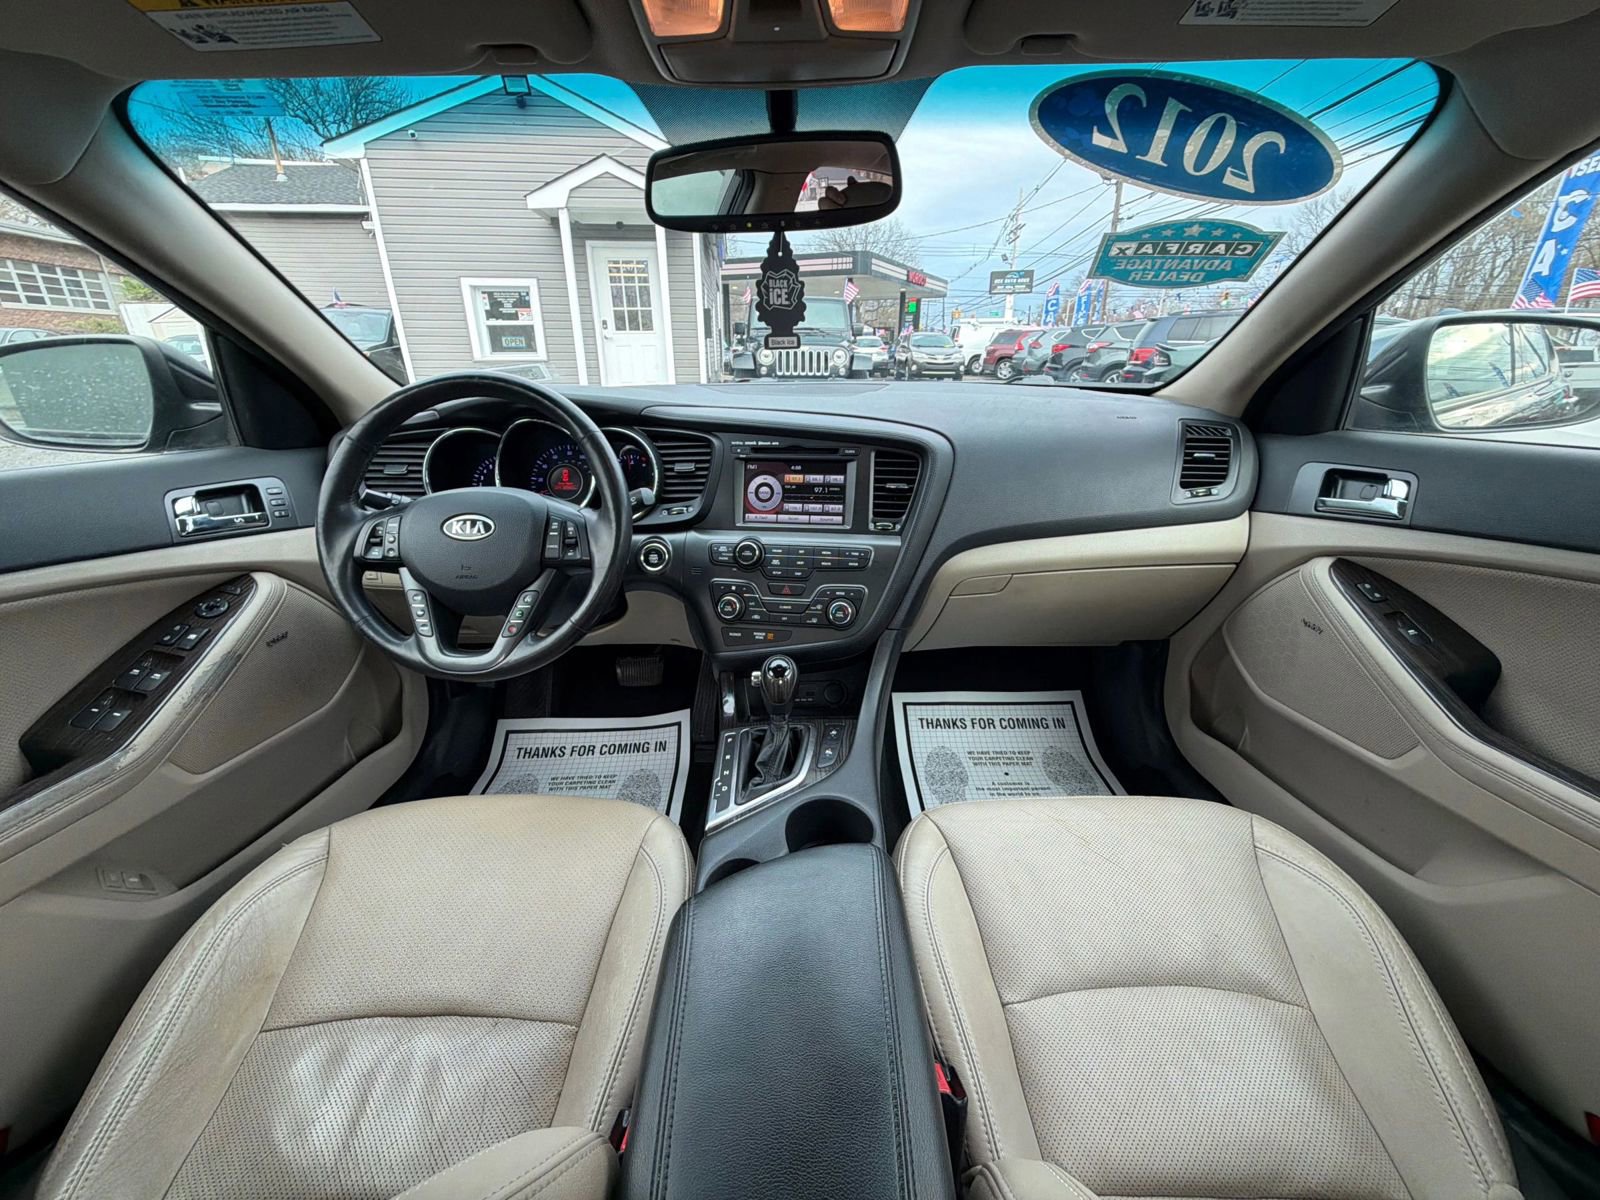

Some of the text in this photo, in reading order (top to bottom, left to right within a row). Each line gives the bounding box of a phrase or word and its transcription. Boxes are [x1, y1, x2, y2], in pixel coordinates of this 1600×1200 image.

[768, 279, 788, 288] BLACK
[504, 337, 524, 345] OPEN
[771, 338, 786, 346] Black
[451, 521, 486, 535] KIA
[918, 717, 1066, 730] THANKS FOR COMING IN
[516, 740, 667, 760] THANKS FOR COMING IN
